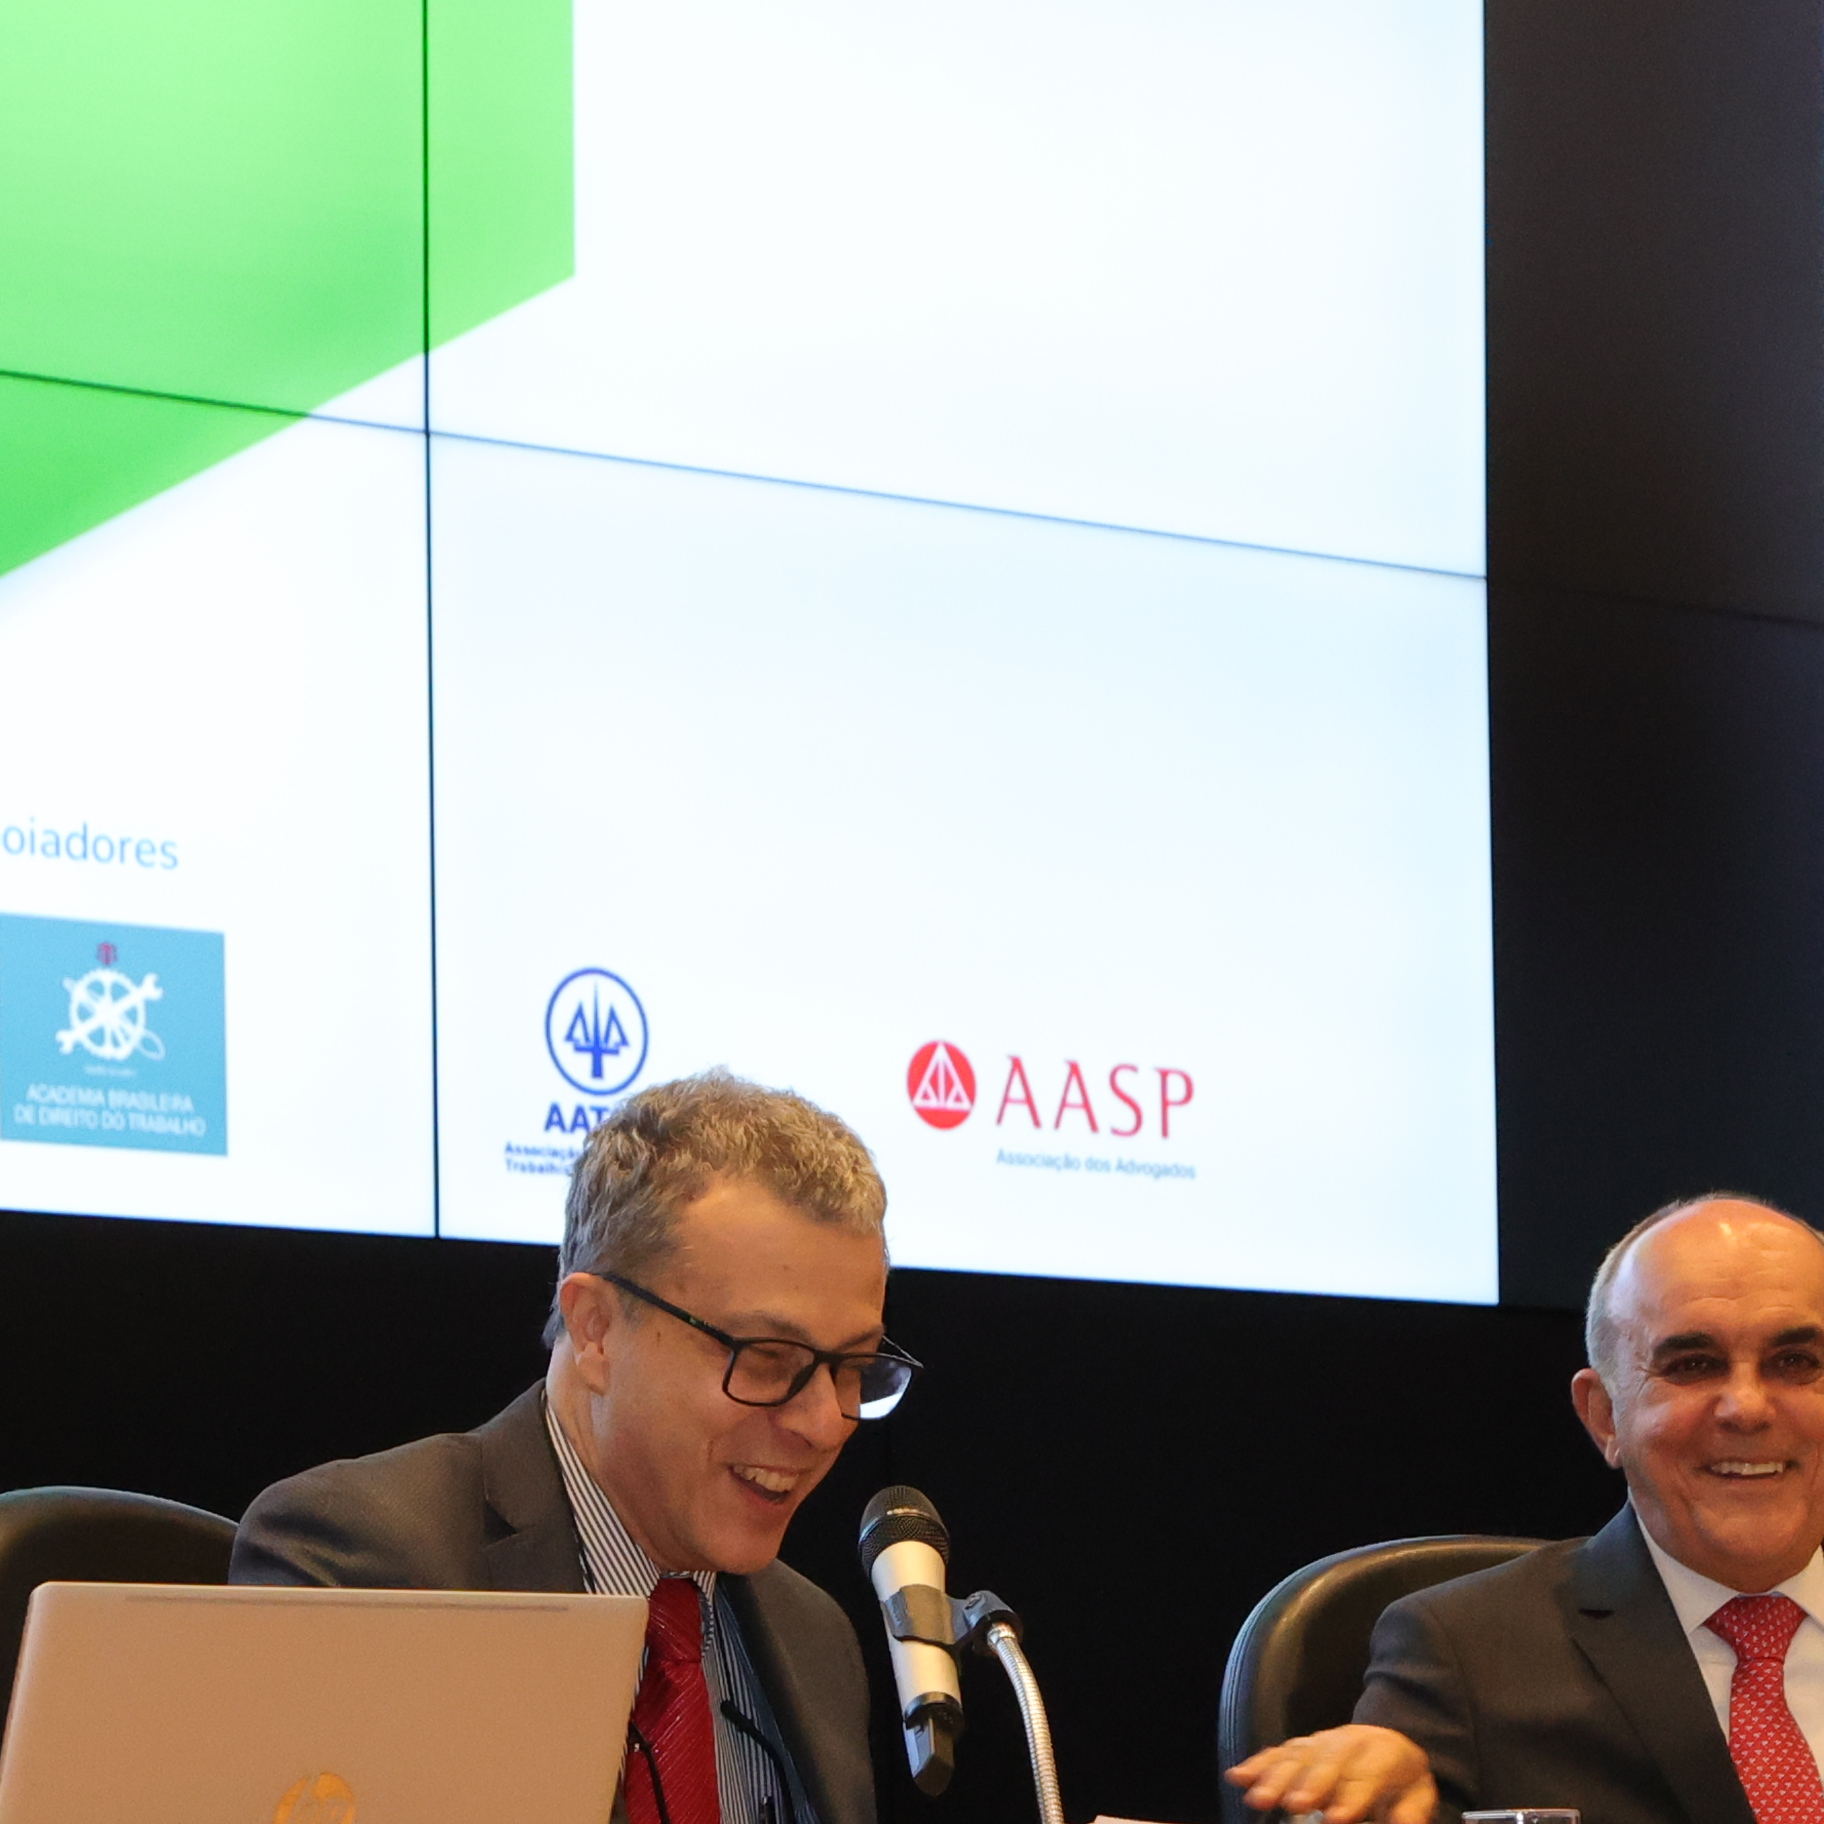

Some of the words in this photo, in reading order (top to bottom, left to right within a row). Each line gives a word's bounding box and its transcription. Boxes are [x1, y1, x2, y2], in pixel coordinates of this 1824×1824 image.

[26, 1083, 105, 1107] ACADEMIA
[108, 1088, 195, 1114] BRASILEIRA
[996, 1054, 1195, 1139] AASP
[13, 1103, 35, 1126] DE
[37, 1106, 99, 1129] DIREITO
[101, 1110, 126, 1131] DO
[128, 1112, 207, 1138] TRABALHO
[996, 1149, 1081, 1172] Associação
[1085, 1155, 1111, 1174] dos
[1115, 1157, 1196, 1180] Advogados
